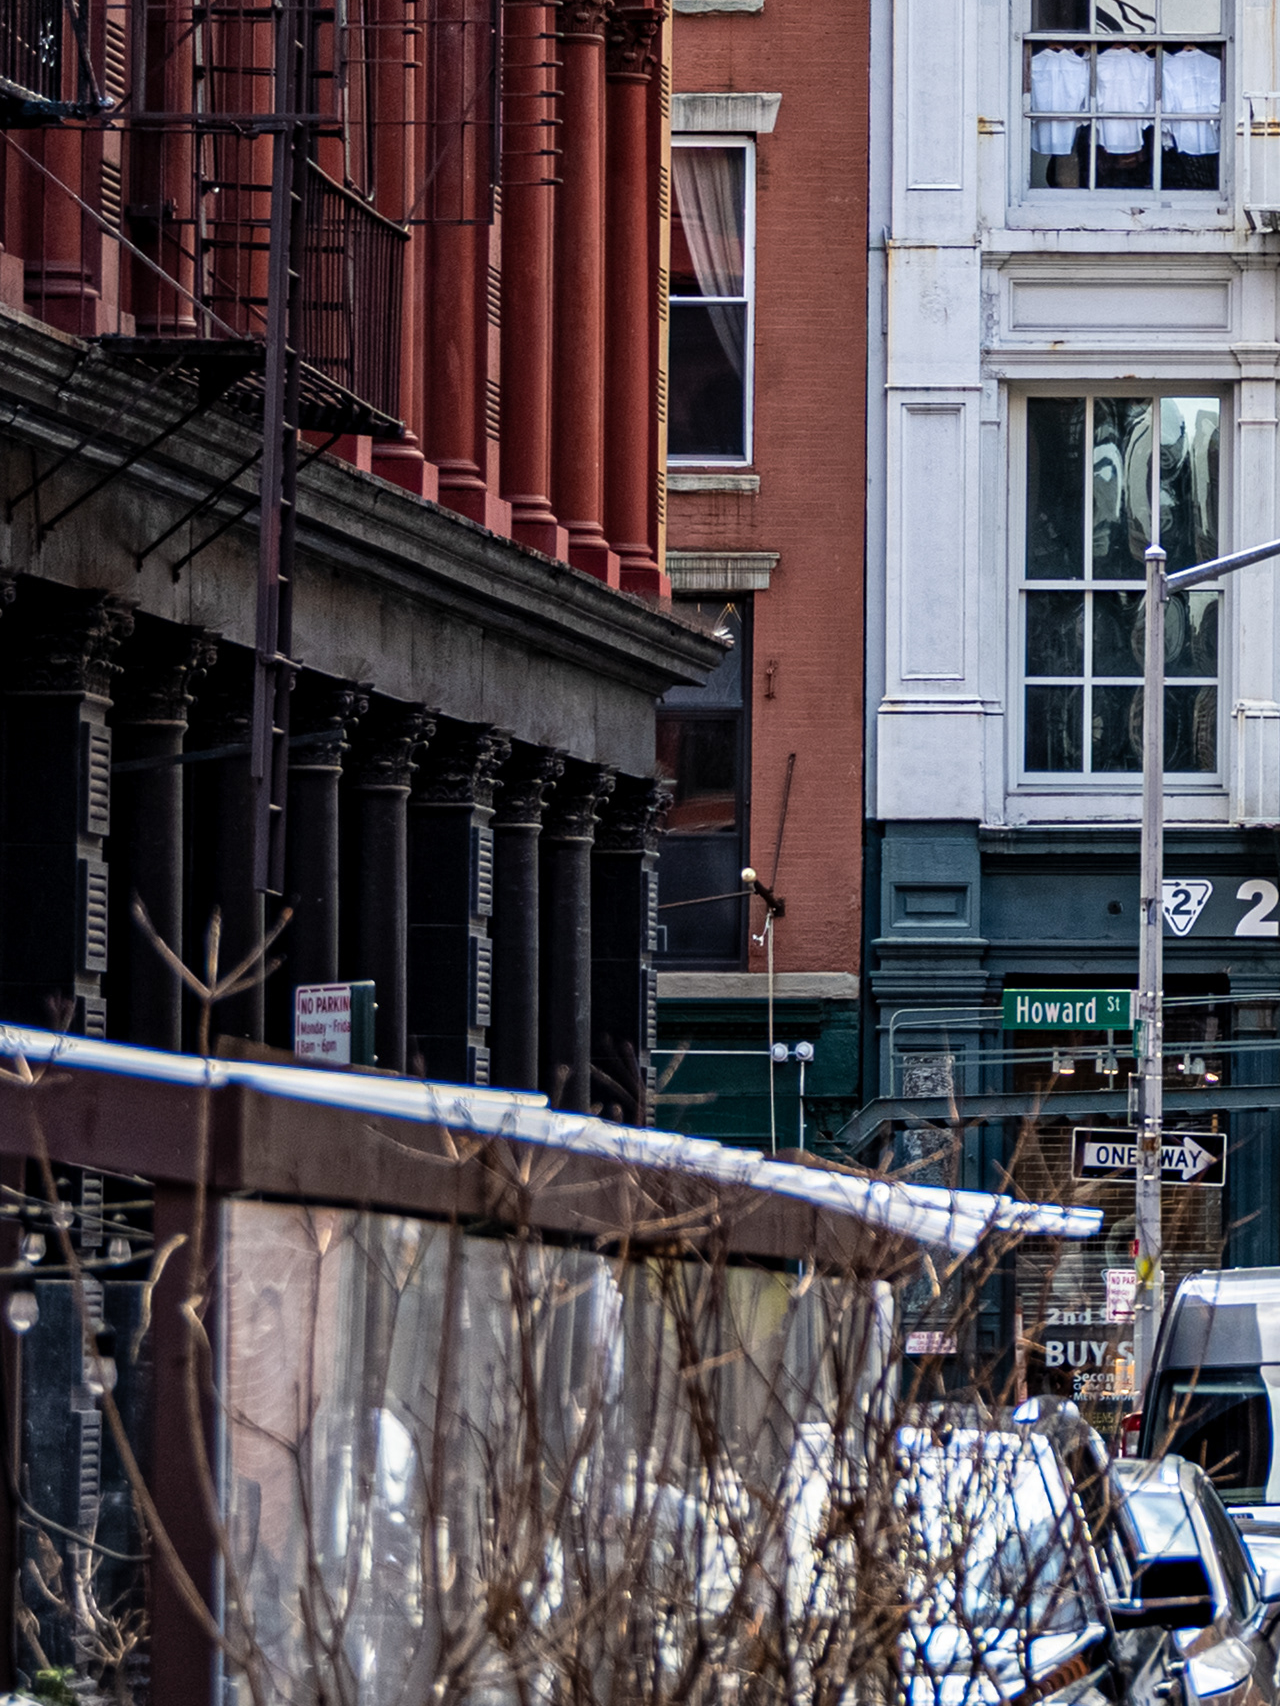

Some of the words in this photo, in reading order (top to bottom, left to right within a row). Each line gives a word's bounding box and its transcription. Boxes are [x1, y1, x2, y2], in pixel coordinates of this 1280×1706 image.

[300, 997, 314, 1015] NO
[316, 995, 350, 1014] PARKIN
[1016, 996, 1097, 1023] Howard
[1107, 996, 1121, 1012] St
[300, 1021, 326, 1038] Monday
[333, 1019, 351, 1033] Frida
[1096, 1145, 1137, 1166] ONE
[1160, 1150, 1202, 1169] WAY
[1045, 1340, 1109, 1367] BUY
[1073, 1369, 1115, 1382] Secon
